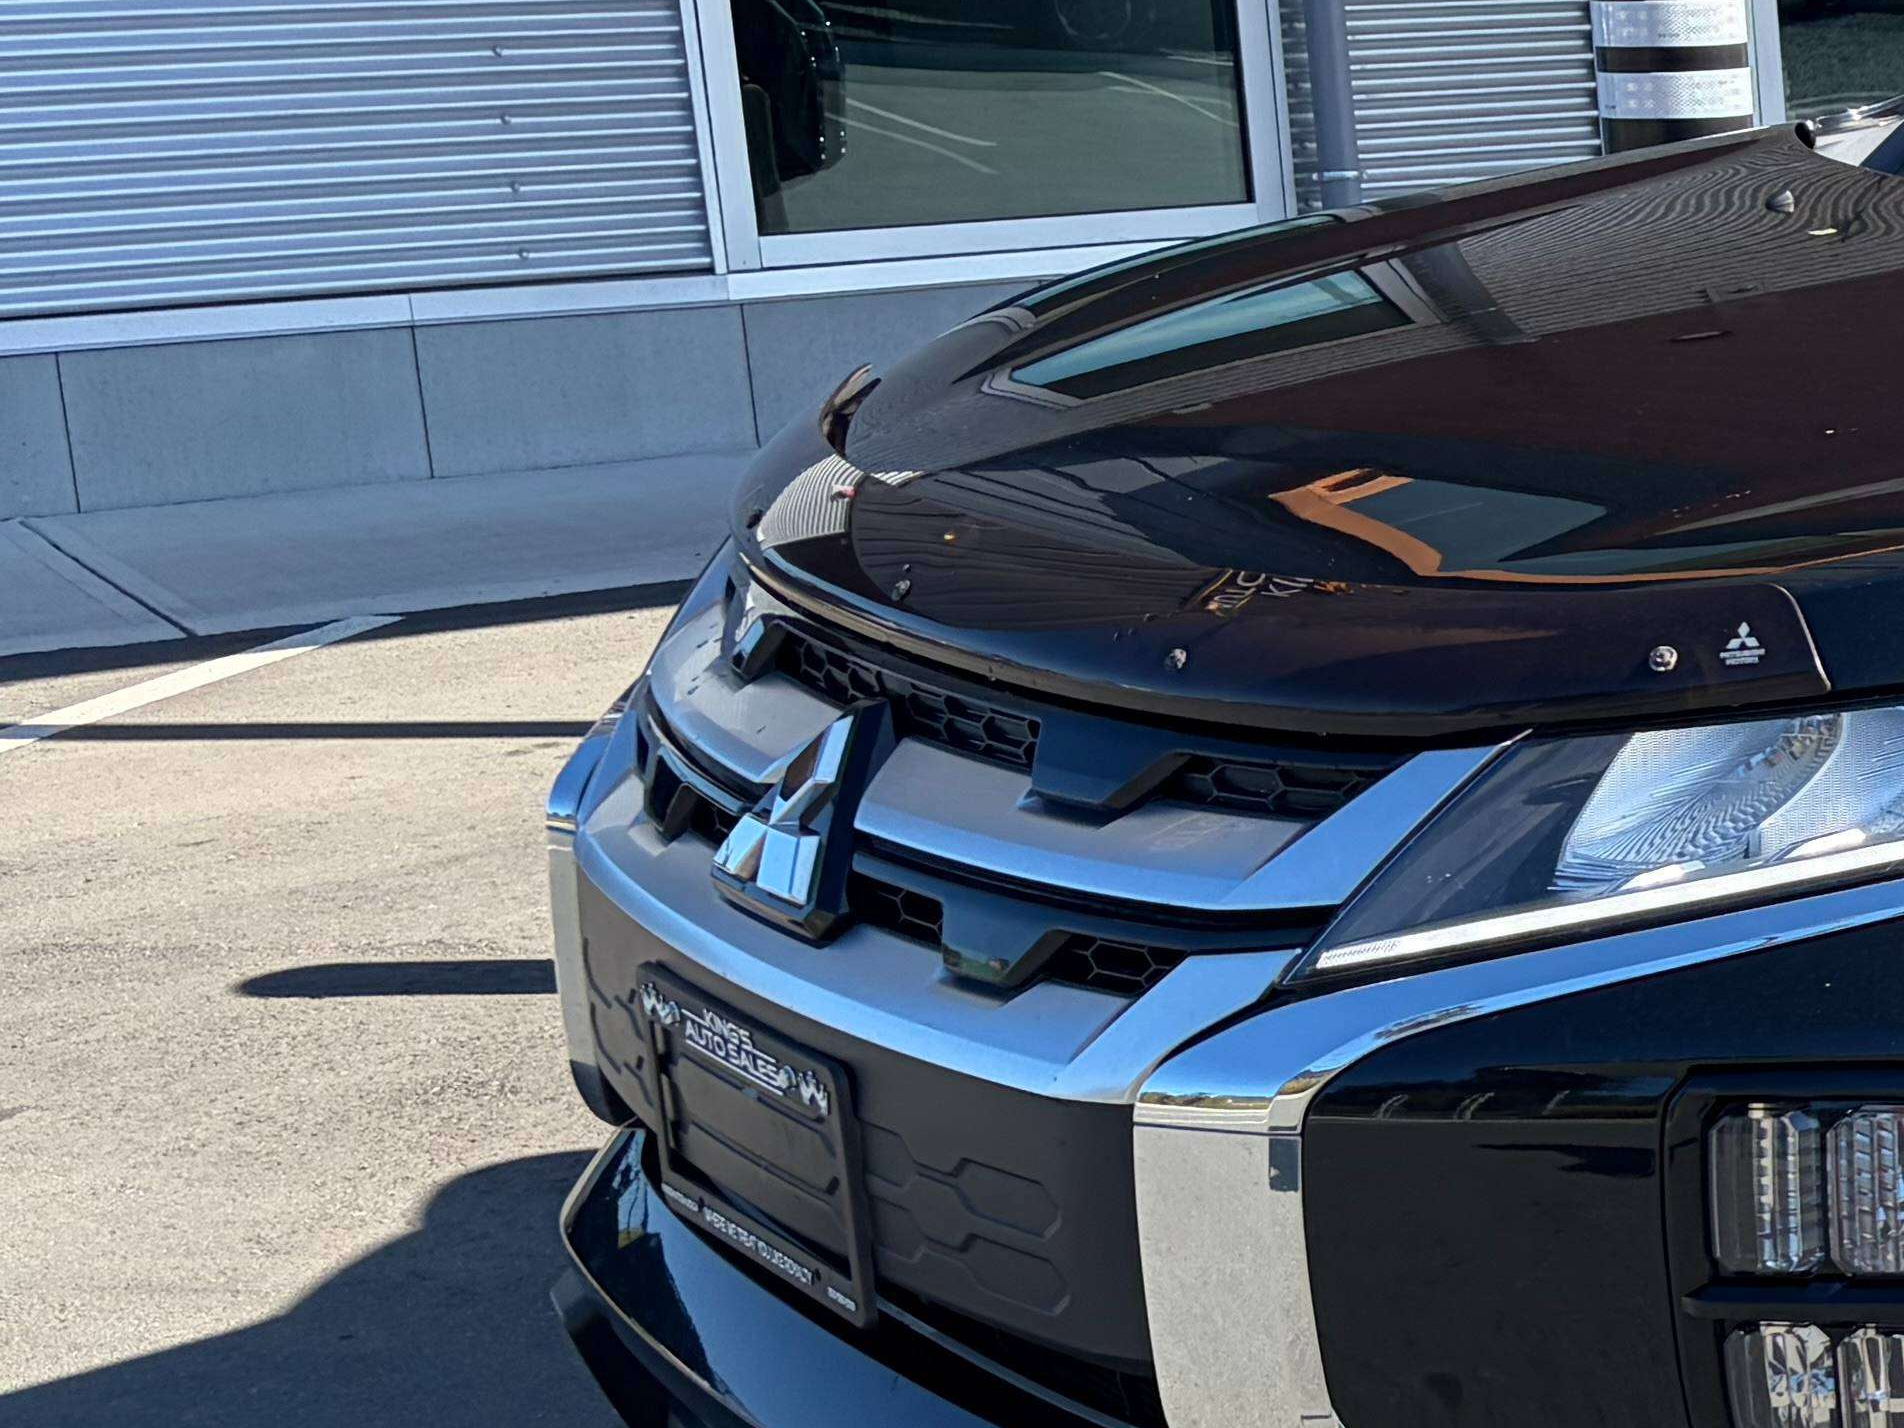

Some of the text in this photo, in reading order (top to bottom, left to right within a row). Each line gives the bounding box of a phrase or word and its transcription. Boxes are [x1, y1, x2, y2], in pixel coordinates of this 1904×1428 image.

[685, 1019, 780, 1086] AUTO SALES
[702, 1008, 754, 1050] KINGS
